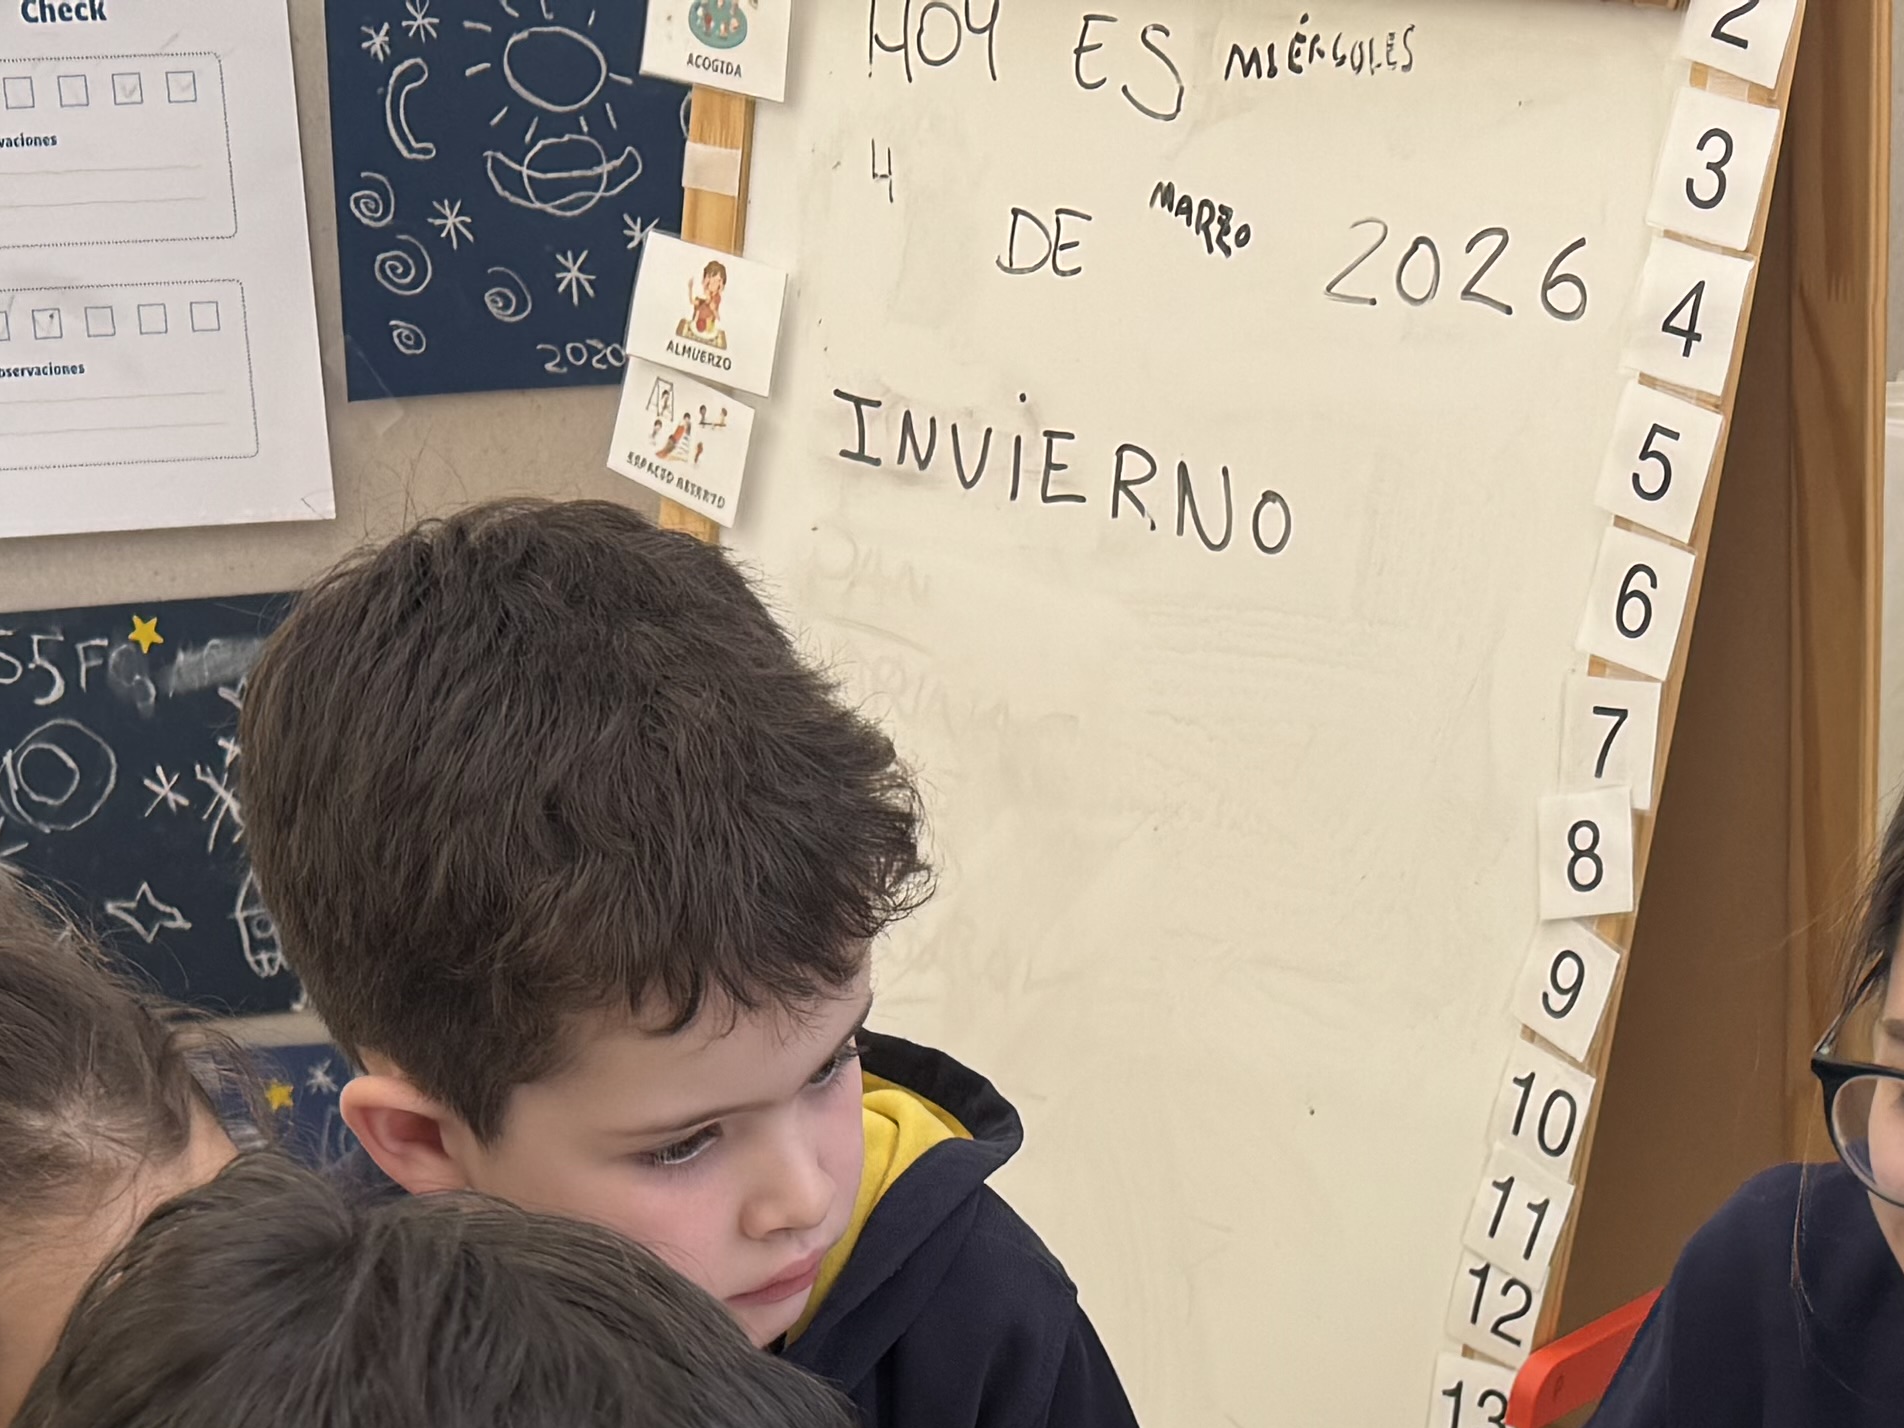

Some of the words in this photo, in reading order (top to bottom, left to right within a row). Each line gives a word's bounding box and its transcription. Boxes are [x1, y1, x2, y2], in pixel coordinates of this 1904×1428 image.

[21, 0, 107, 24] Check
[1711, 0, 1759, 49] 2
[686, 52, 742, 78] ACOGIDA
[868, 0, 1000, 83] HOY
[1073, 14, 1184, 121] ES
[871, 139, 895, 203] 4
[1685, 128, 1734, 210] 3
[996, 207, 1092, 277] DE
[1149, 180, 1252, 258] MARZO
[1325, 218, 1590, 322] 2026
[666, 340, 732, 371] ALMUERZO
[1661, 280, 1703, 358] 4
[1631, 424, 1680, 502] 5
[1616, 563, 1658, 639] 6
[1592, 705, 1629, 779] 7
[1566, 820, 1604, 893] 8
[1542, 949, 1585, 1020] 9
[1511, 1071, 1577, 1158] 10
[1490, 1176, 1551, 1261] 11
[1468, 1262, 1533, 1348] 12
